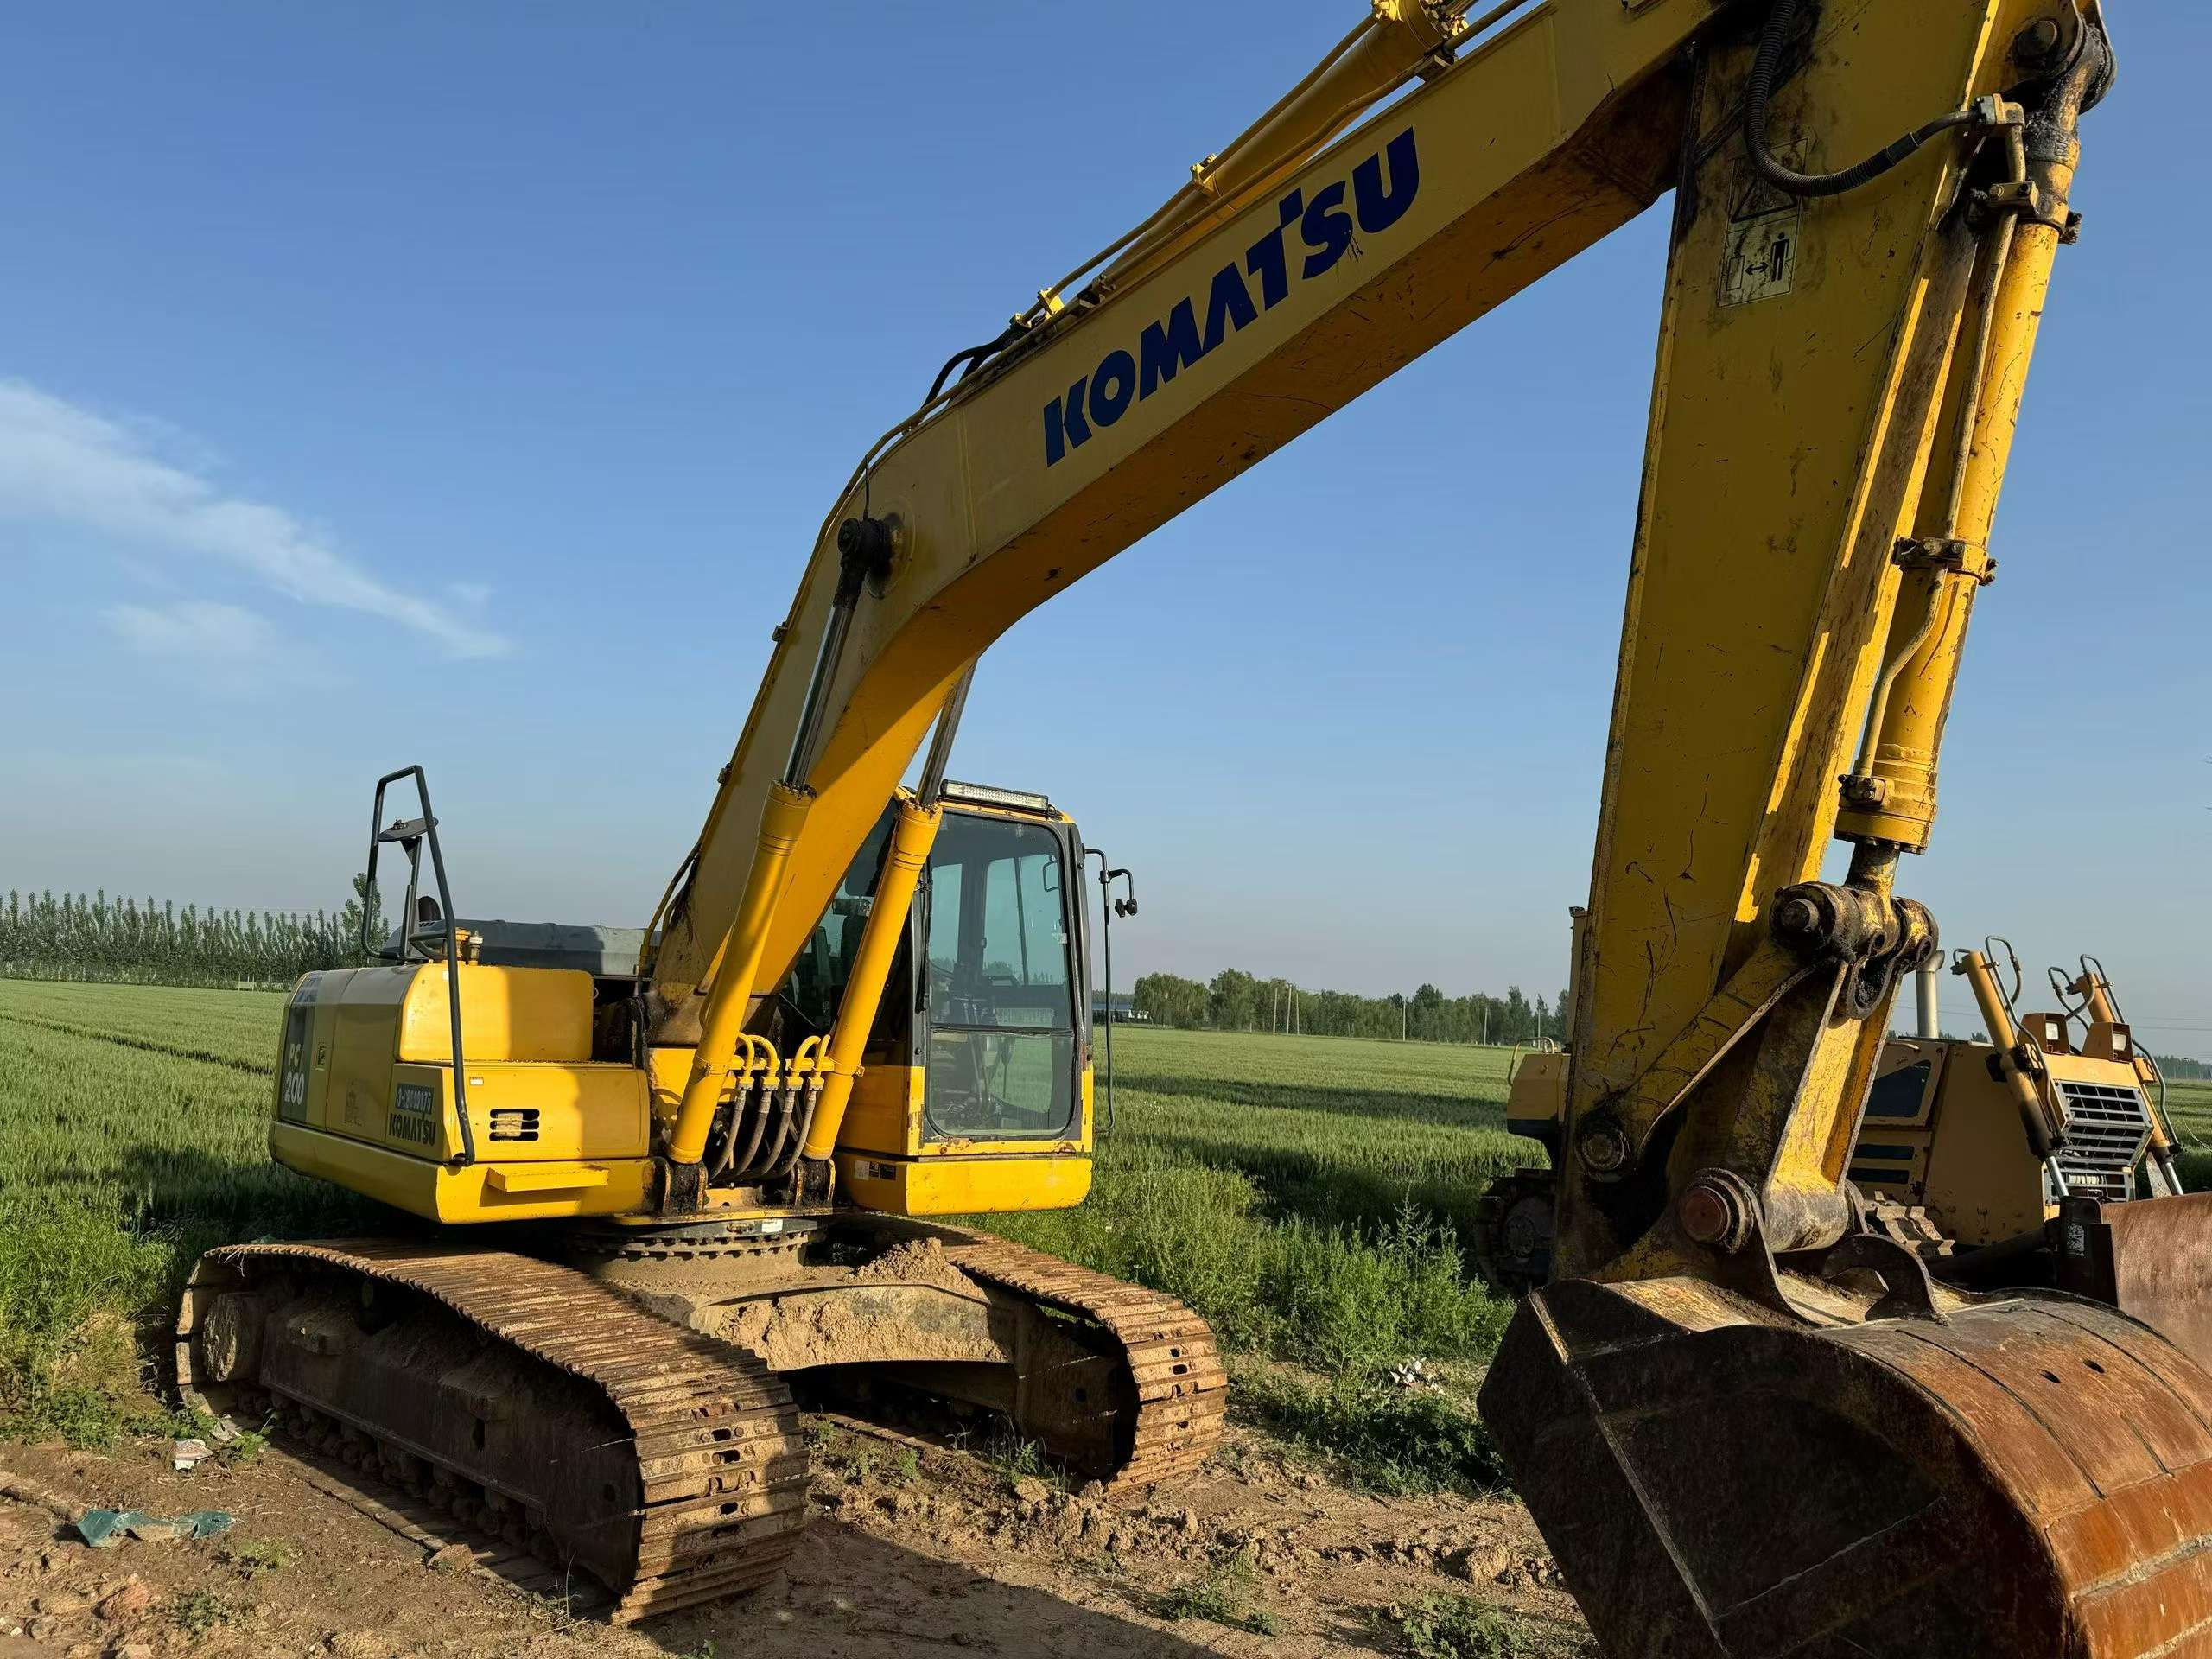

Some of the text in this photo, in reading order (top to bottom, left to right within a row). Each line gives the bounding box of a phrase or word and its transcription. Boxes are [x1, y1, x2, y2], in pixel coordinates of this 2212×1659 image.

[1043, 125, 1420, 468] KOMATSU
[289, 1044, 302, 1065] PC
[284, 1071, 304, 1105] 200
[389, 1112, 436, 1147] KOMATSU
